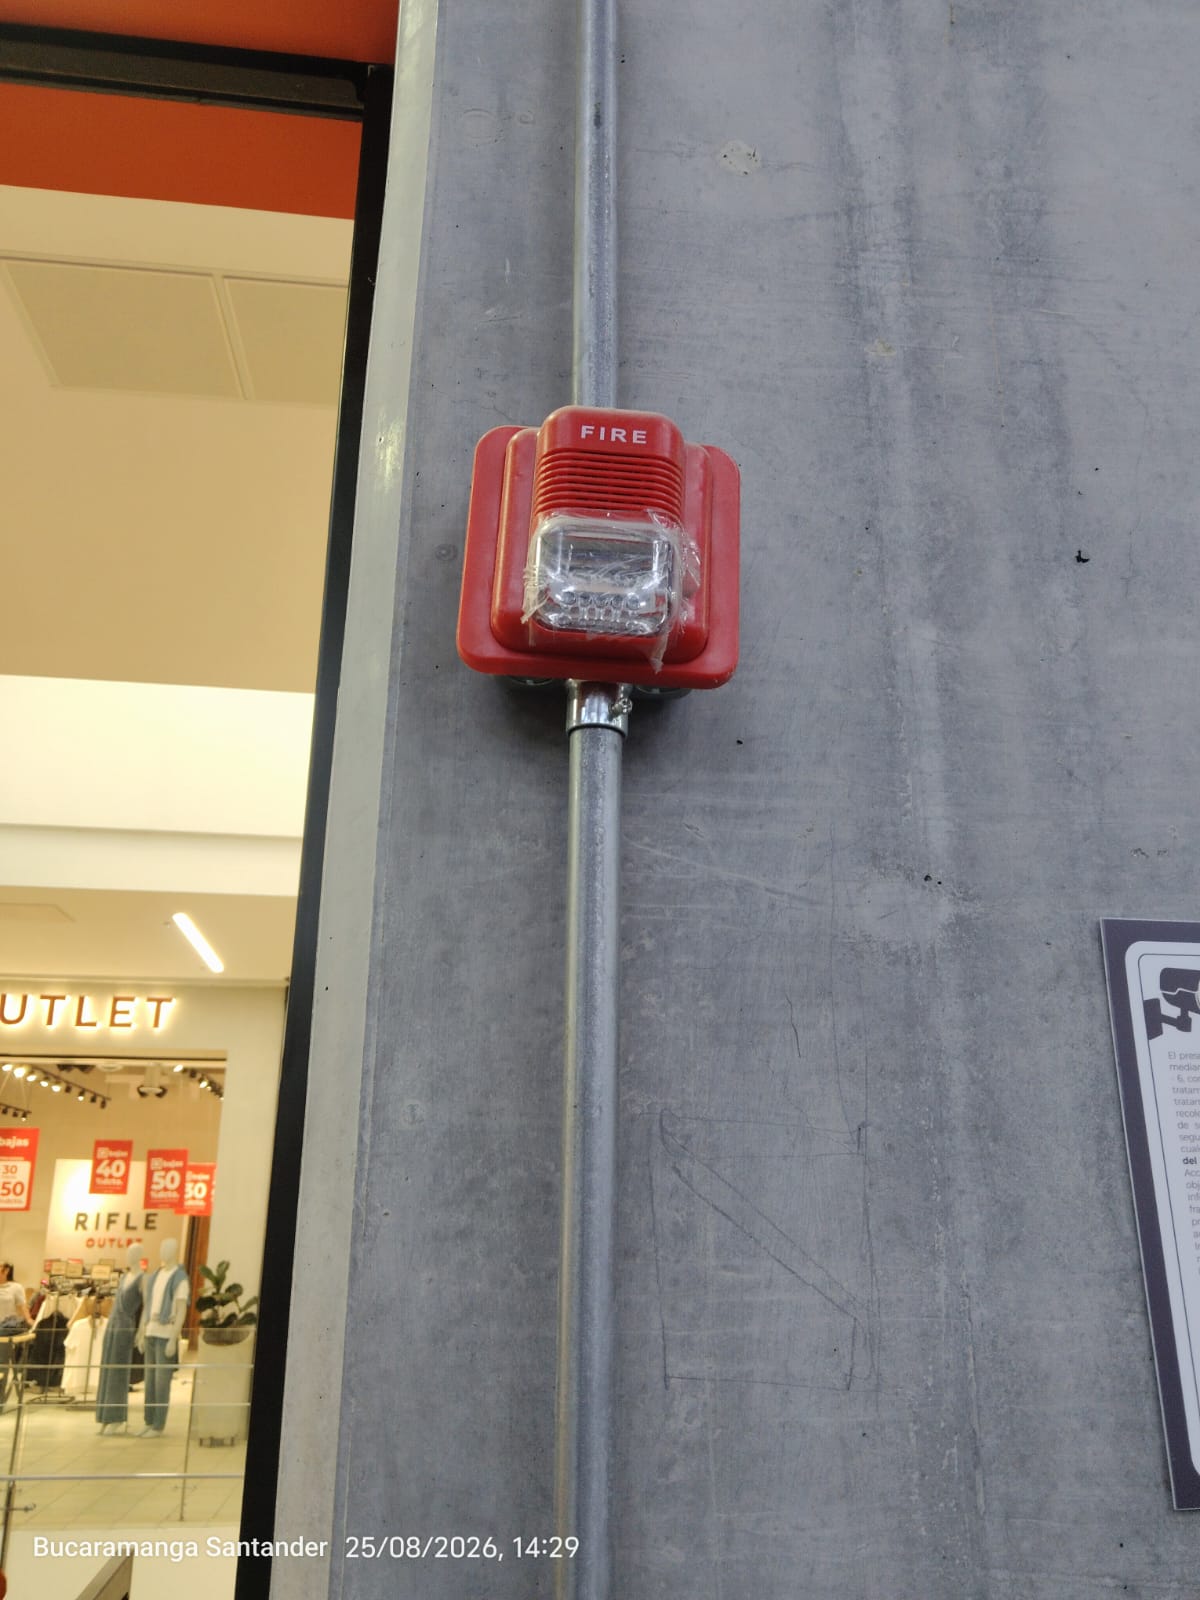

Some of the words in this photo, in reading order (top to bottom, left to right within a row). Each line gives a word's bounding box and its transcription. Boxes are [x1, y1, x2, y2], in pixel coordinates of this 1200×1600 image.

[580, 425, 647, 444] FIRE
[0, 993, 174, 1028] UTLET
[96, 1159, 126, 1178] 40
[1182, 1156, 1197, 1164] del
[0, 1181, 25, 1196] 50
[150, 1170, 181, 1190] 50
[74, 1212, 158, 1231] RIFLE
